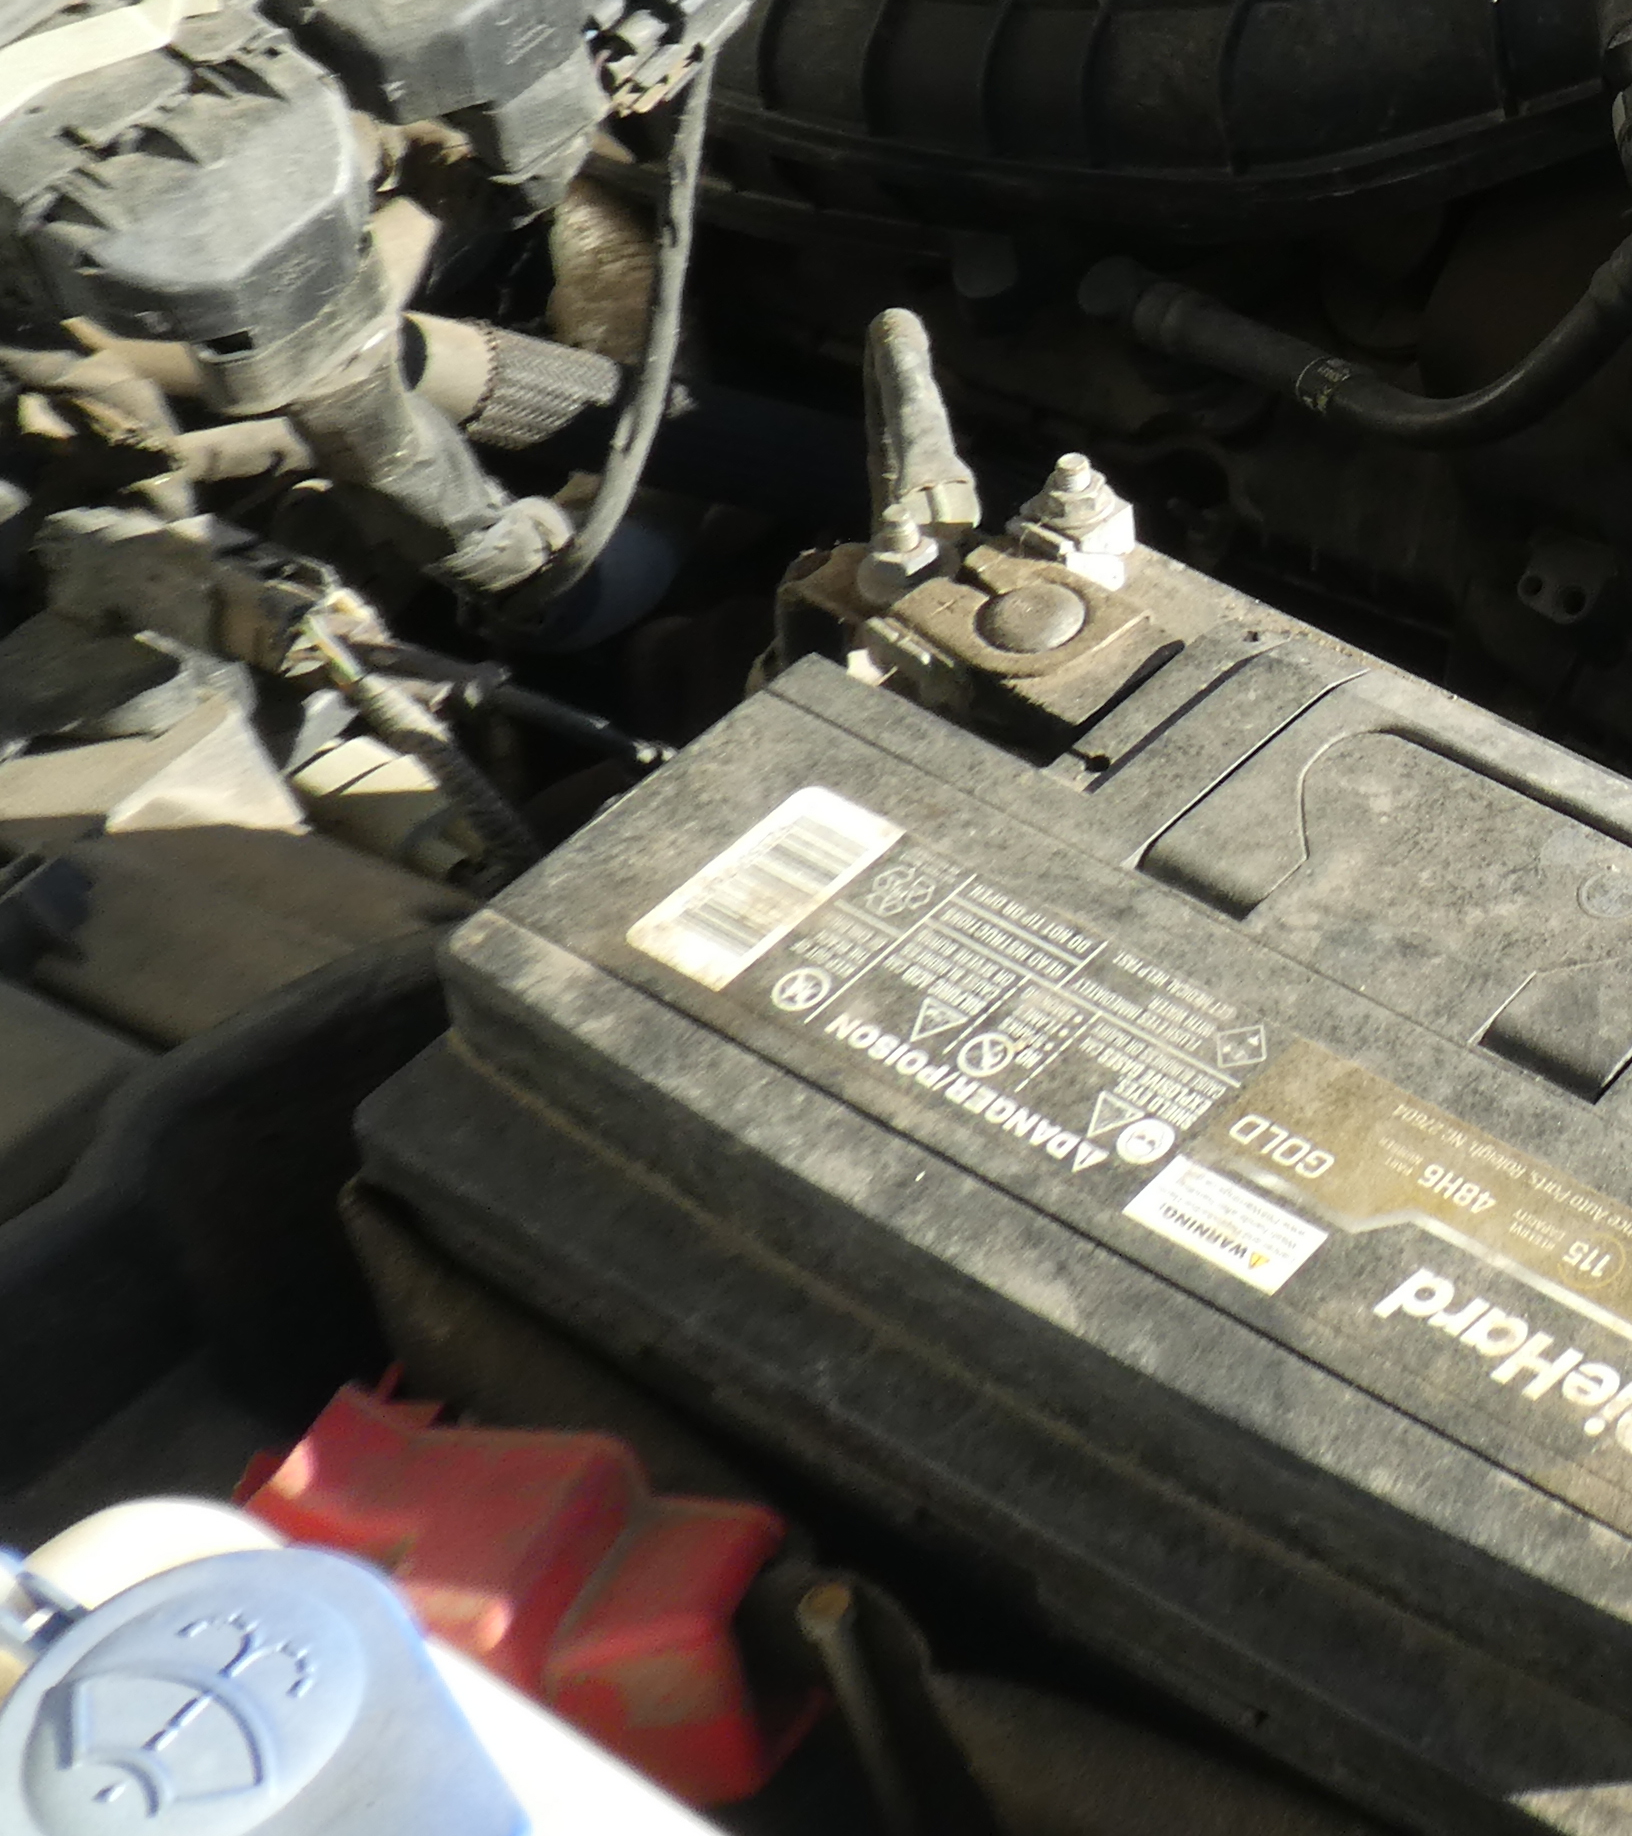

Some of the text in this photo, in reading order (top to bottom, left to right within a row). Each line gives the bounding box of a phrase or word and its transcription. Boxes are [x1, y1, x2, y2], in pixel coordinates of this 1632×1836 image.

[999, 899, 1028, 921] OR
[1018, 909, 1048, 931] TIP
[1038, 919, 1074, 945] NOT
[1063, 932, 1093, 955] DO
[1135, 962, 1171, 987] HELP
[1092, 1044, 1147, 1080] GASES
[822, 1009, 1082, 1159] DANGER/POISON
[1134, 1066, 1214, 1115] EXPLOSIVE
[1142, 1093, 1198, 1131] SHIELD
[1391, 1100, 1445, 1137] 27604
[1226, 1109, 1337, 1181] GOLD
[1440, 1126, 1468, 1148] NC
[1415, 1161, 1498, 1218] 48H6
[1565, 1191, 1609, 1223] Auto
[1560, 1237, 1613, 1279] 115
